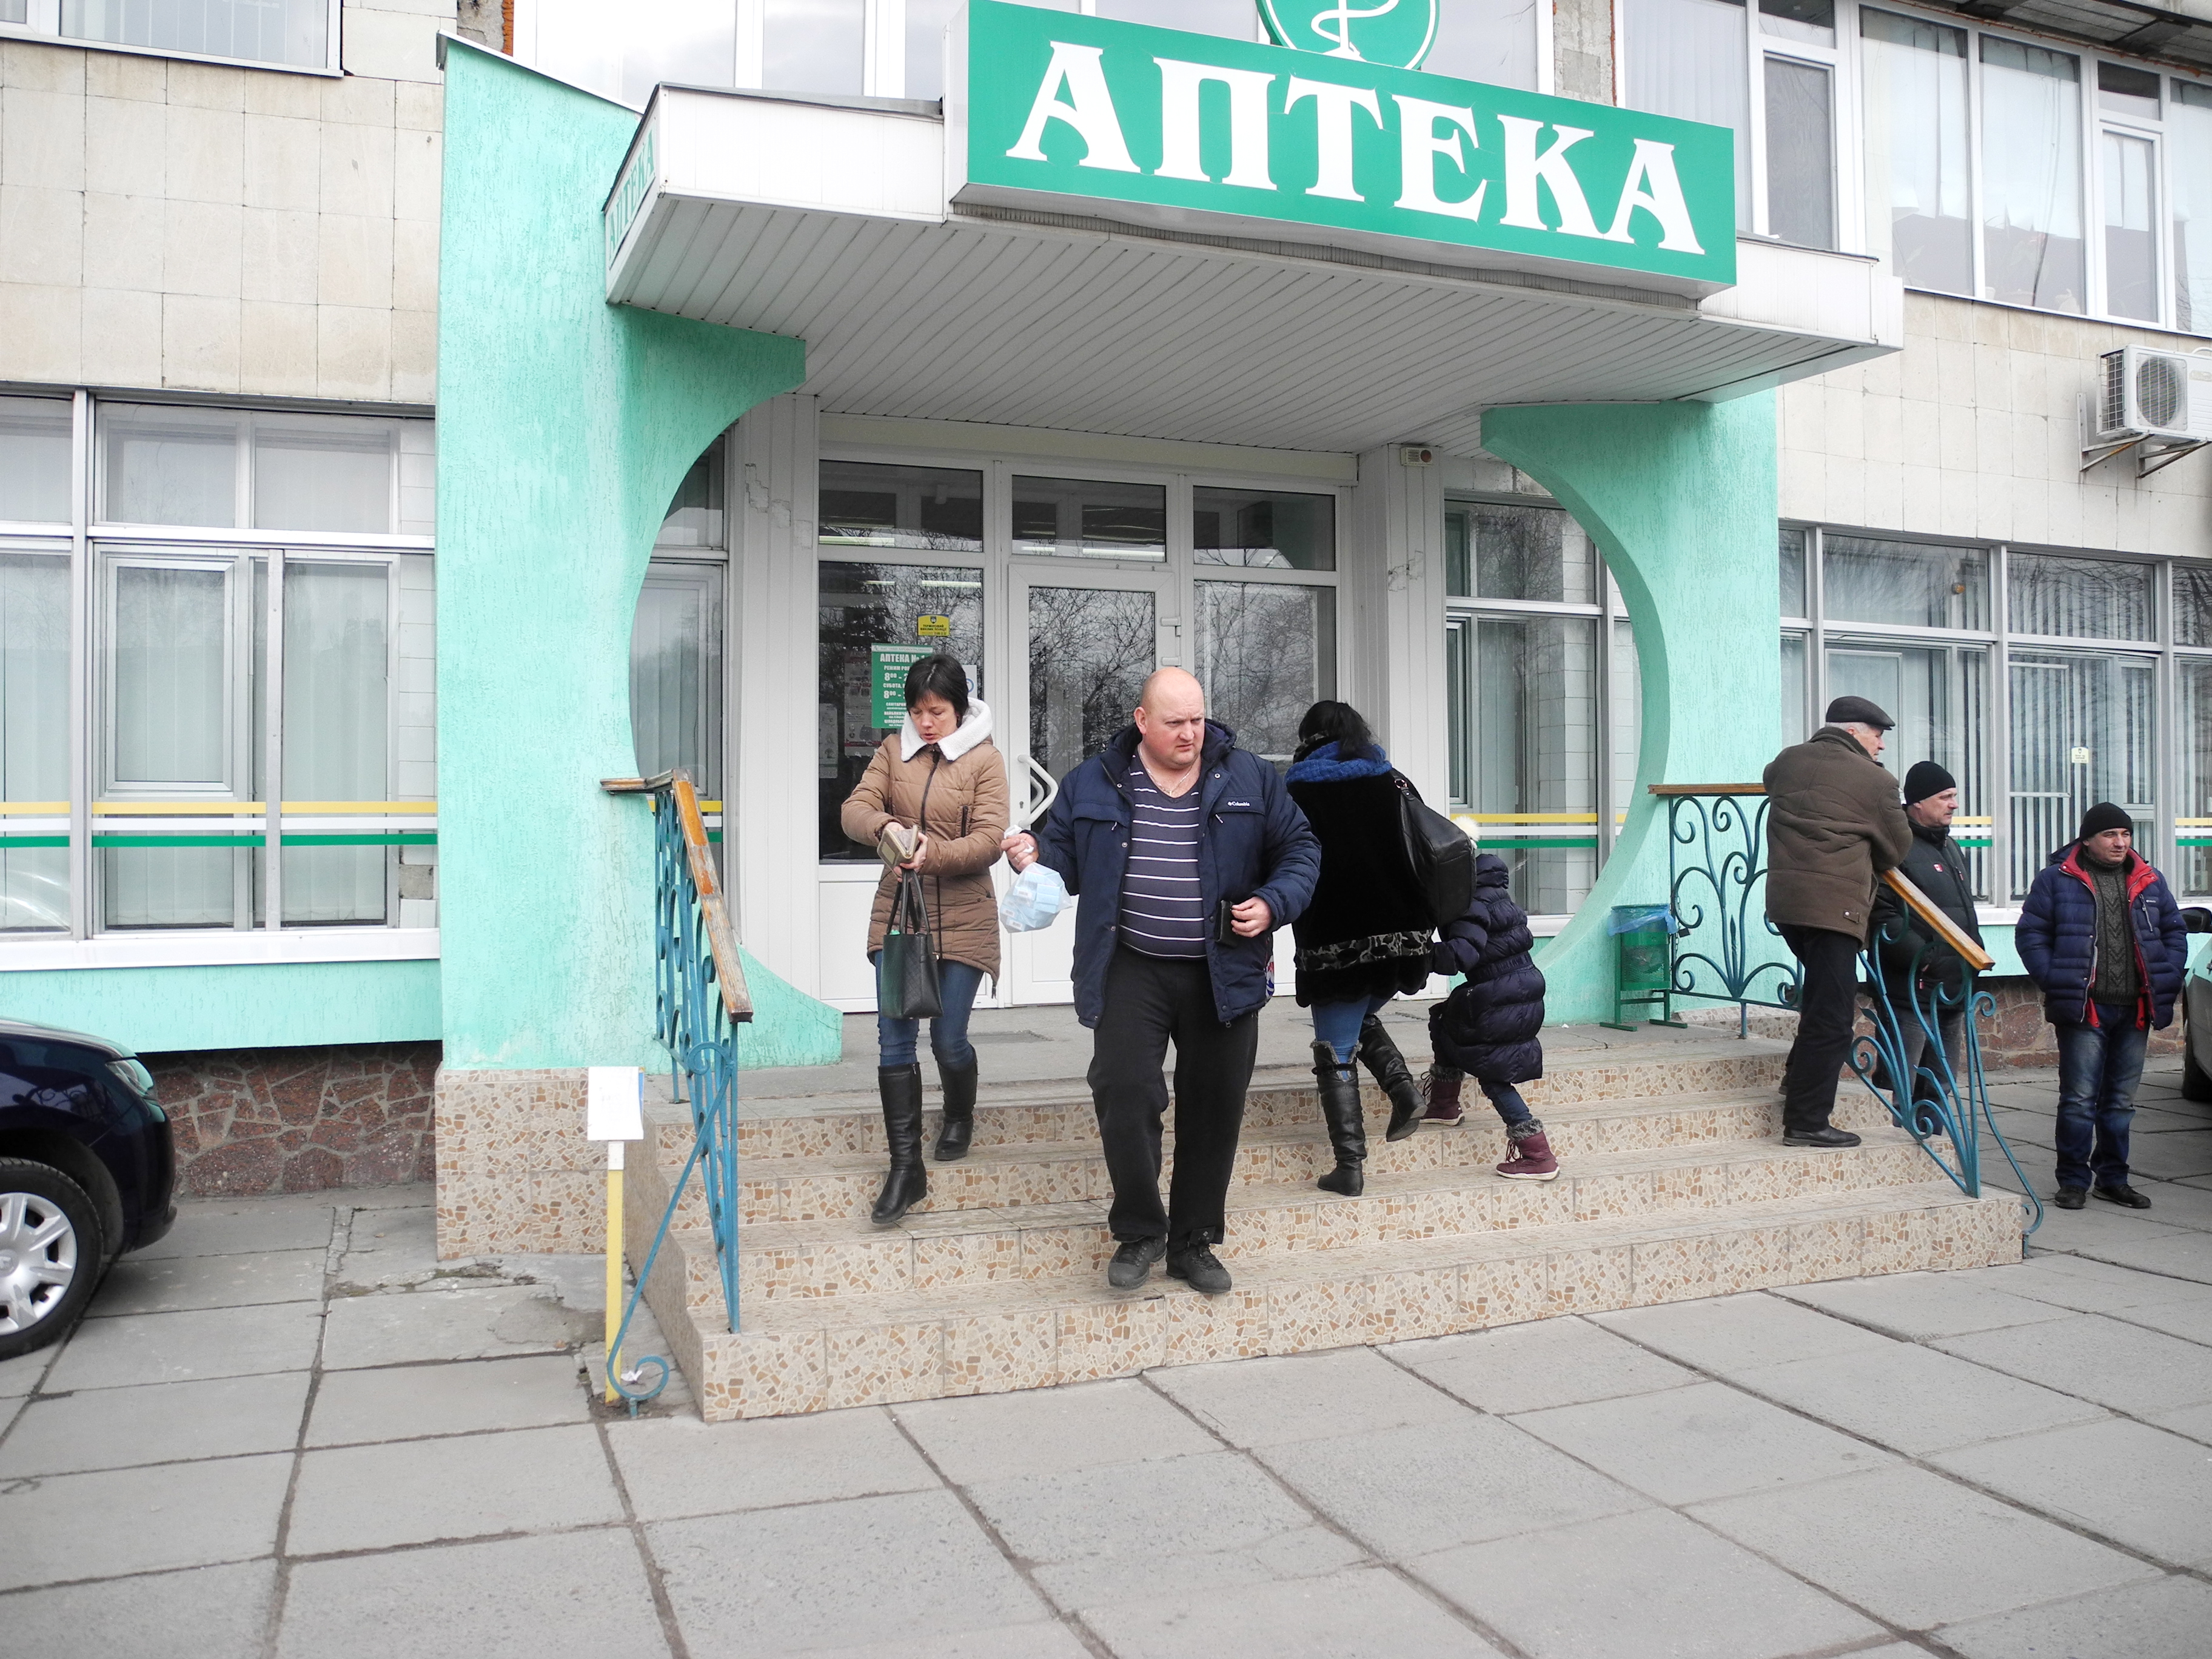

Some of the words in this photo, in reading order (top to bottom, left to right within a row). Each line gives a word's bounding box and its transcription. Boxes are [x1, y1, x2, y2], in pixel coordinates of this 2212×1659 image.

[609, 128, 654, 261] АПТЕКА
[1005, 40, 1706, 255] АПТЕКА
[880, 654, 910, 663] АПТЕКА
